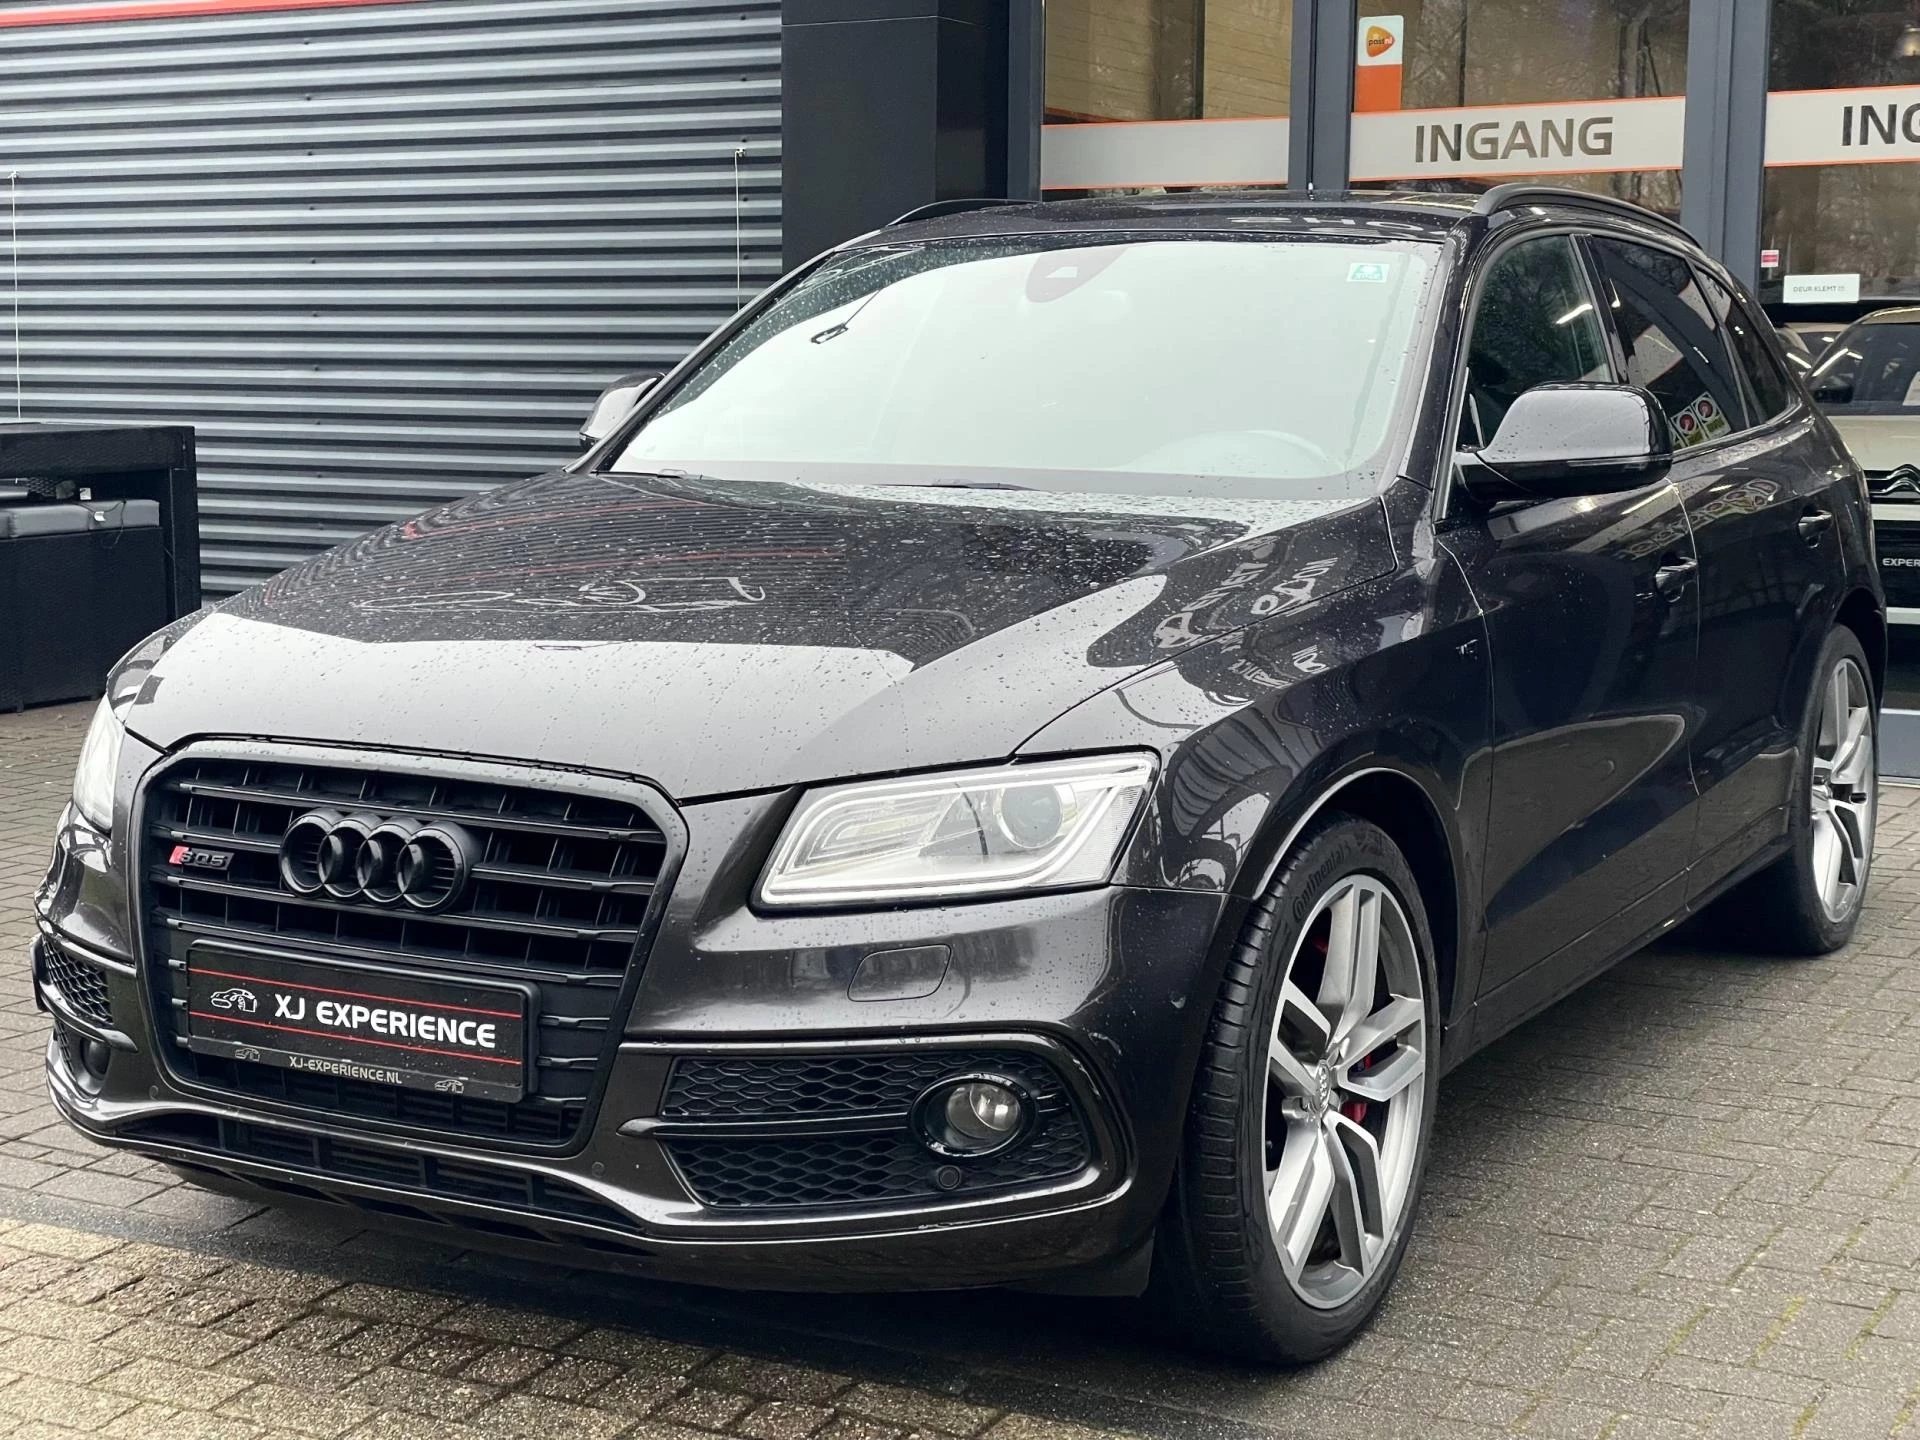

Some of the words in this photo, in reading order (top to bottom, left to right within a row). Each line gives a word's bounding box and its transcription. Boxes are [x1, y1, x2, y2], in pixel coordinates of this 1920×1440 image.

[1415, 116, 1613, 163] INGANG
[1882, 557, 1920, 567] EXPER
[180, 850, 226, 868] SQ5
[274, 993, 305, 1020] XJ
[315, 1000, 496, 1049] EXPERIENCE
[289, 1055, 402, 1085] XJ-EXPERIENCE.NL
